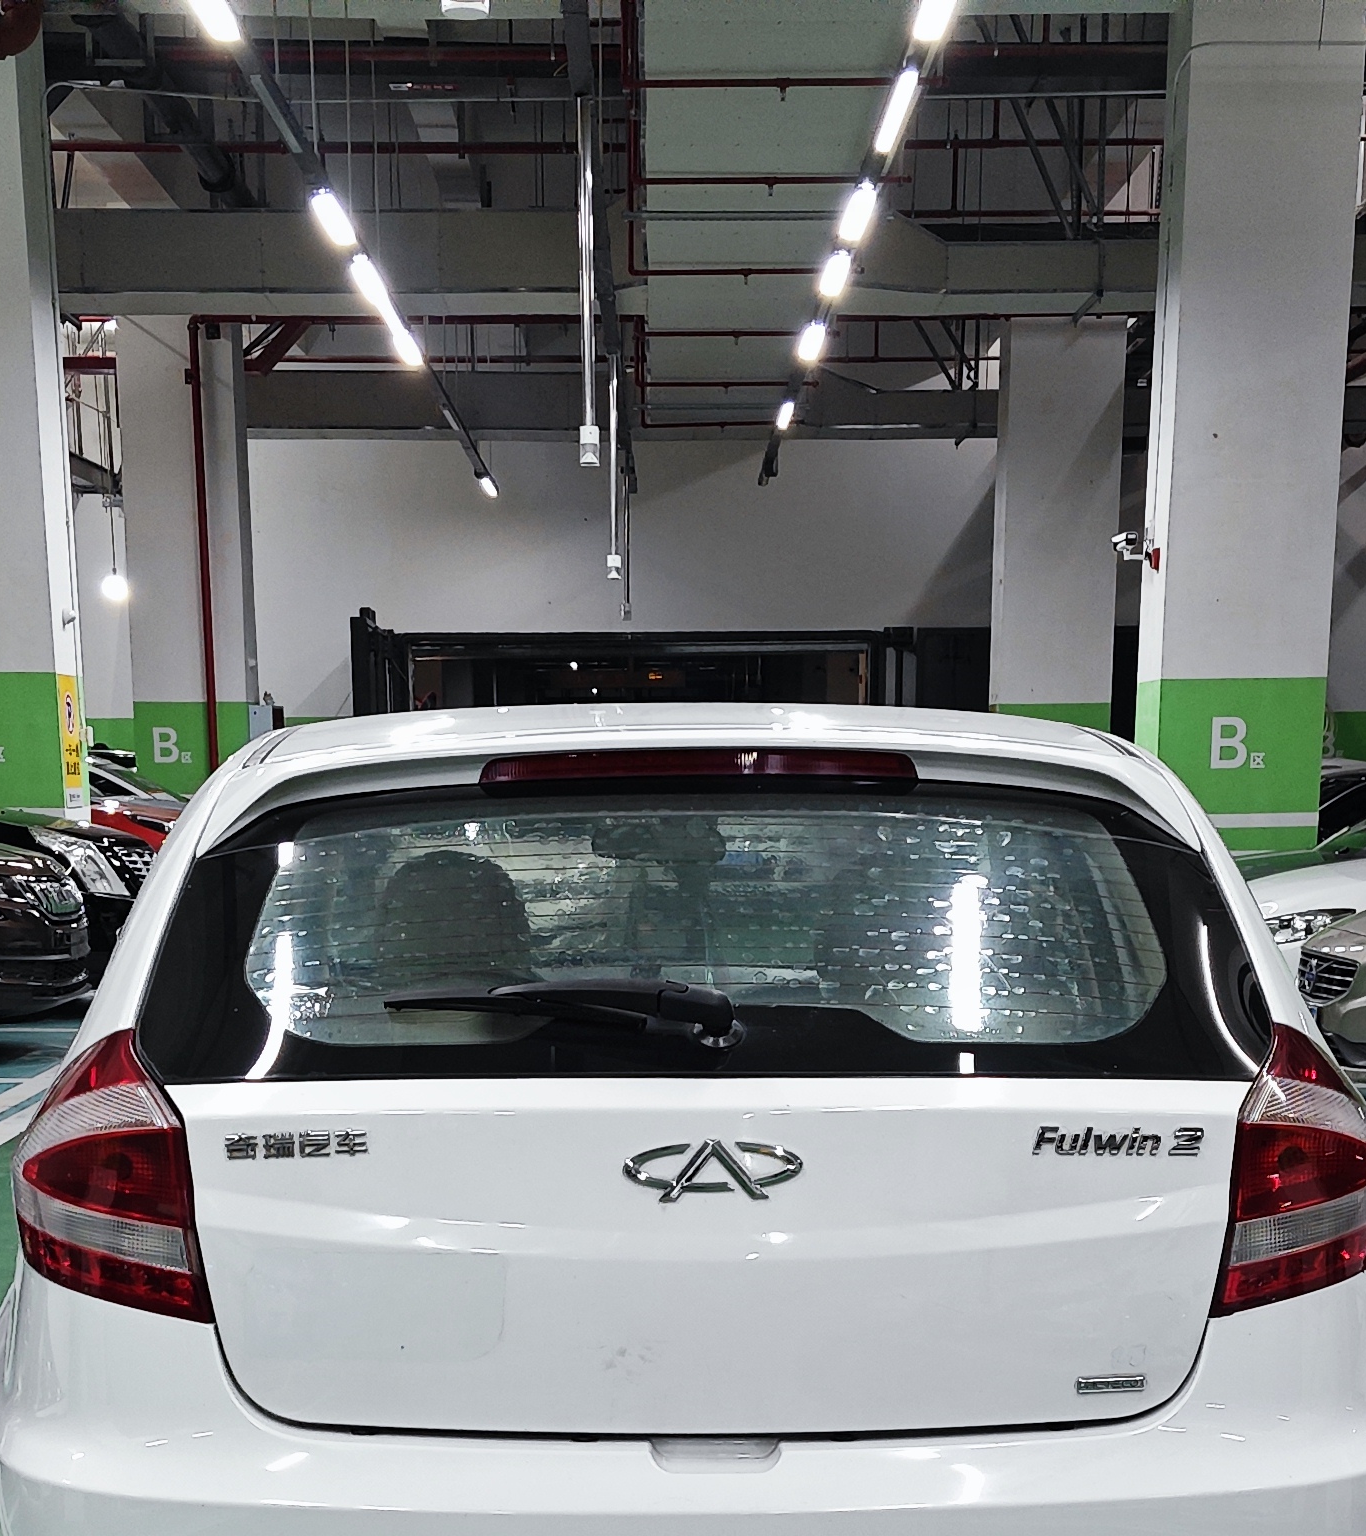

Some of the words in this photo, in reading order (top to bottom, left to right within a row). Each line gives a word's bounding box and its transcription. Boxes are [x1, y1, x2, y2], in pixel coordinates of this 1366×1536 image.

[151, 727, 193, 764] B区
[1209, 716, 1266, 769] B区
[224, 1129, 369, 1160] 奇瑞汽车
[1032, 1126, 1162, 1157] Fulwin
[1168, 1127, 1205, 1157] 2
